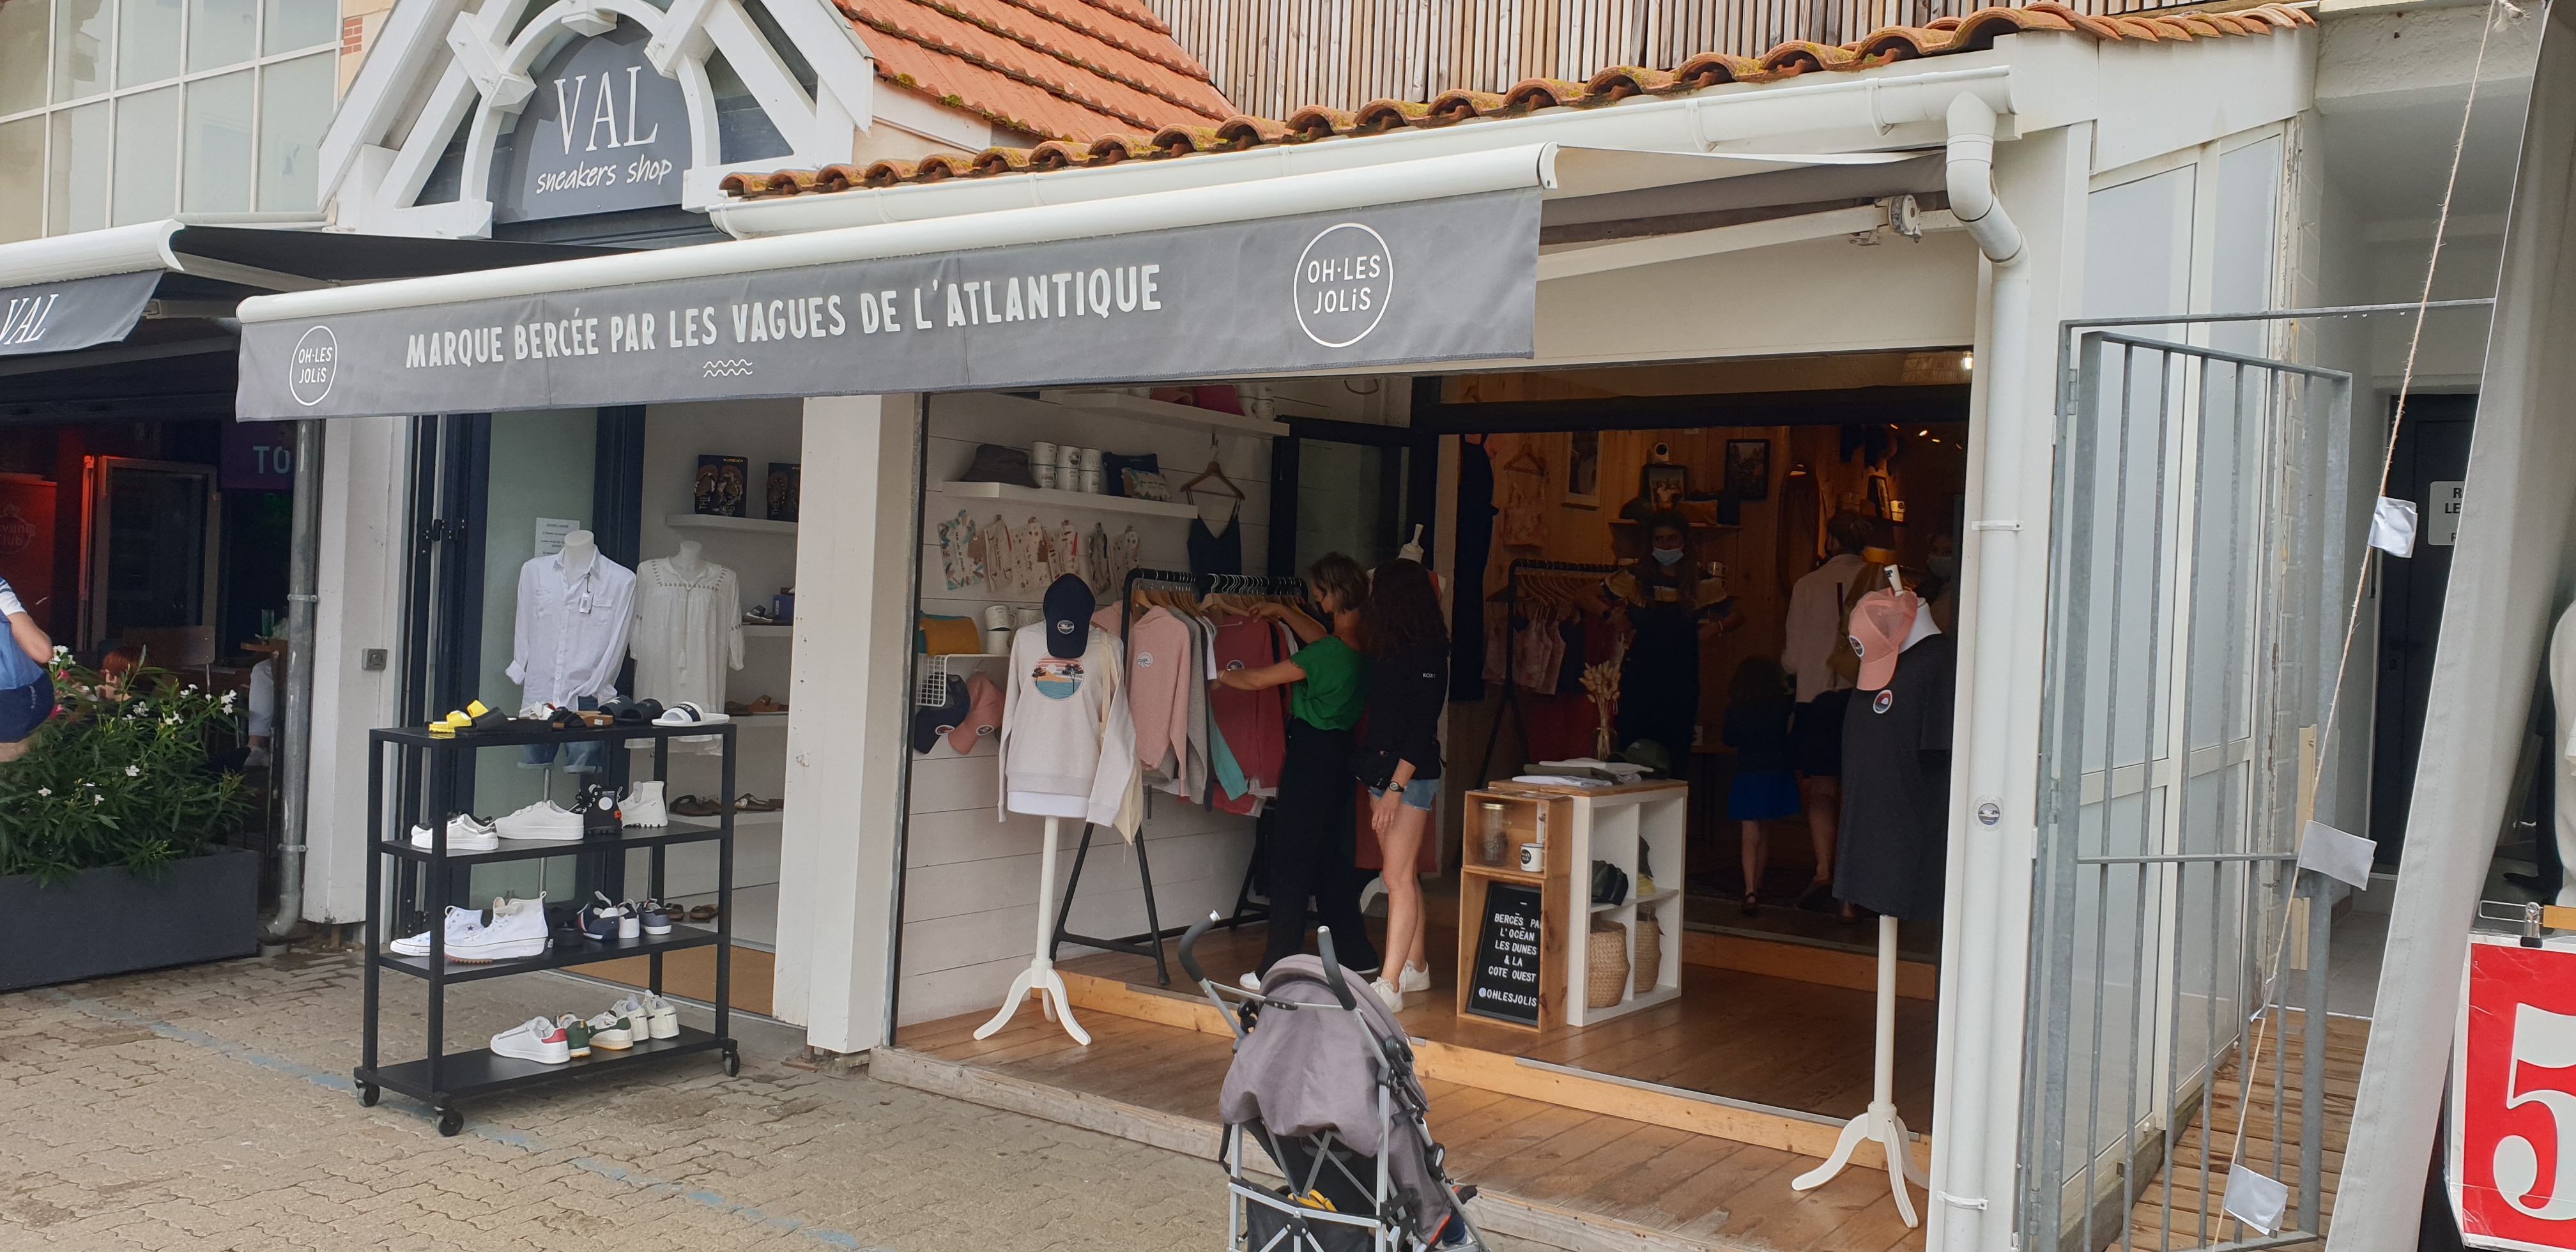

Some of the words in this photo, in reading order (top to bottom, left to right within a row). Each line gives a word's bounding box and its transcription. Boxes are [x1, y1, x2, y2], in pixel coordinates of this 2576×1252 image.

[554, 66, 658, 155] VAL
[536, 161, 617, 194] sneakers
[627, 154, 672, 185] shop
[0, 294, 59, 344] VAL
[406, 327, 503, 368] MARQUE
[514, 308, 599, 360] BERCÉE
[611, 314, 655, 353] PAR
[670, 307, 717, 348] LES
[732, 295, 845, 343] VAGUES
[861, 291, 900, 334] DE
[914, 264, 1161, 329] L'ATLANTIQUE
[1494, 940, 1510, 950] LES
[1512, 942, 1537, 955] DUNES
[1504, 954, 1510, 965] &
[1512, 956, 1522, 966] LA
[1488, 965, 1508, 978] COTE
[1512, 970, 1537, 983] OUEST
[1478, 987, 1537, 1007] @OHLESJOLIS
